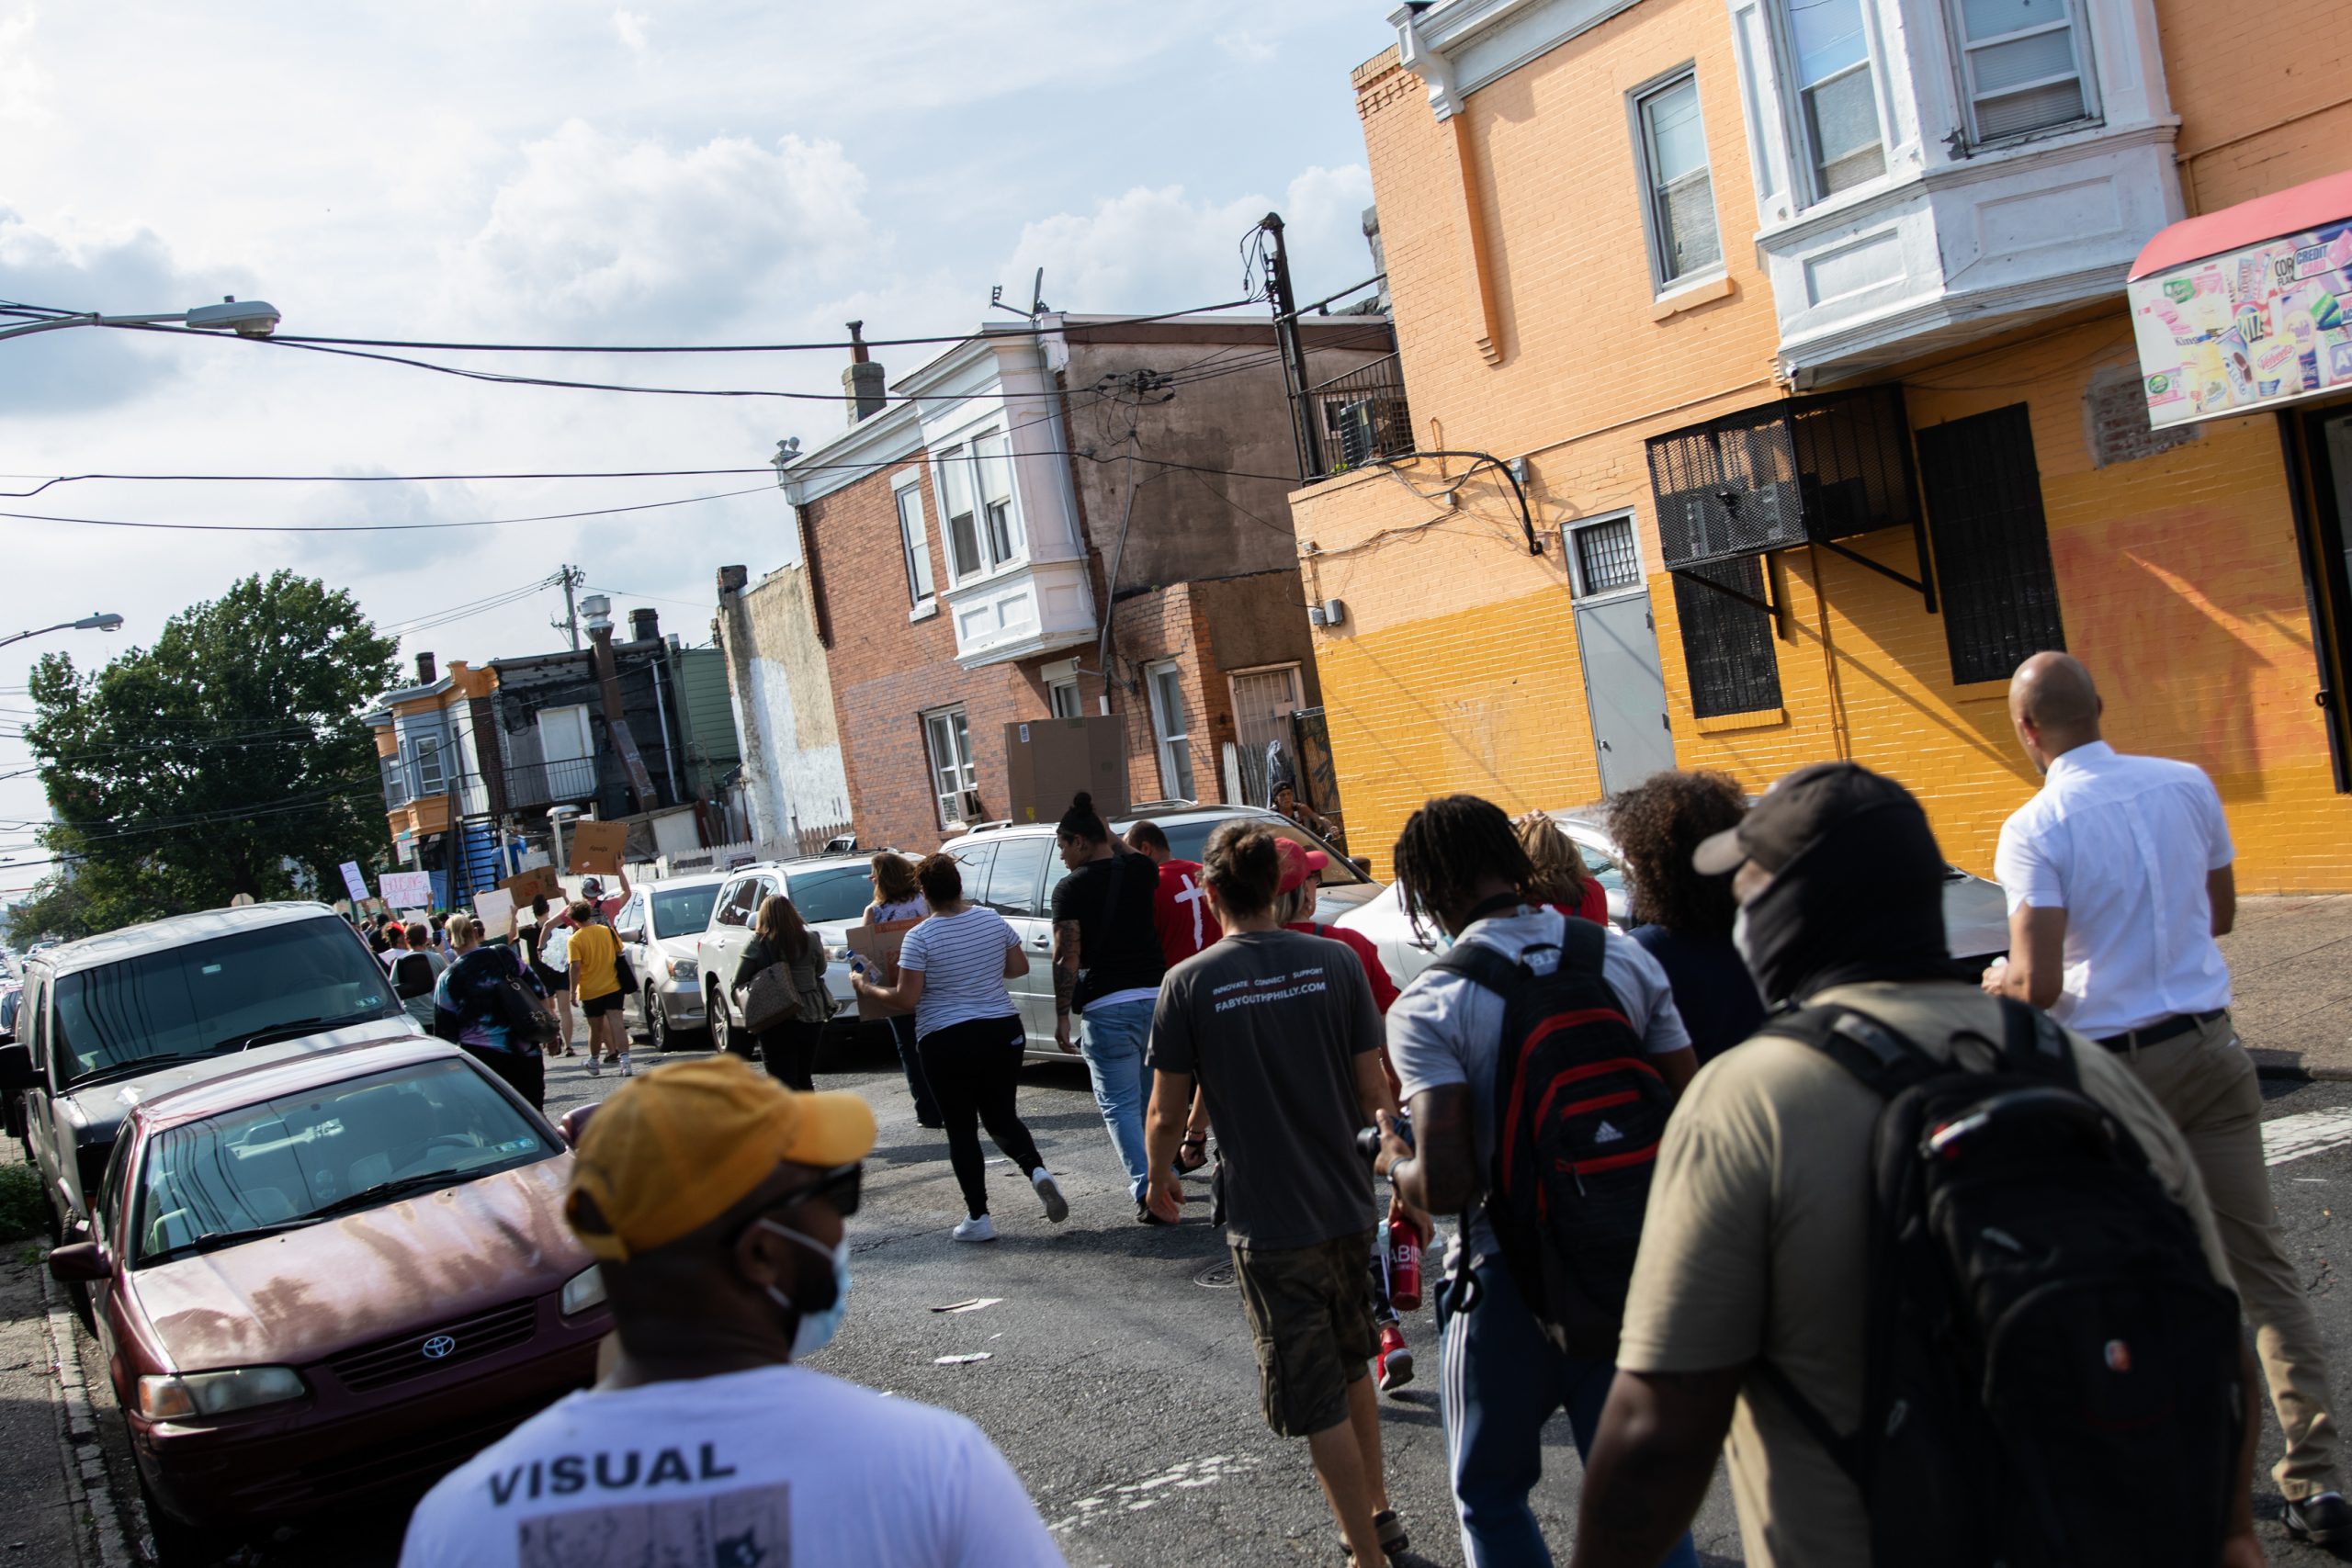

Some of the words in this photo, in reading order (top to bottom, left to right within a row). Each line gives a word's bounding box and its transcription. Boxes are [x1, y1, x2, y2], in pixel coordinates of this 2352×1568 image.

[2297, 245, 2328, 265] CREDIT
[2236, 314, 2264, 342] RITZ
[1213, 980, 1249, 995] INNOVATE
[1253, 976, 1286, 987] CONNECT
[1293, 967, 1324, 979] SUPPORT
[1215, 982, 1326, 1013] FABYOUTHPHILLY.COM
[489, 1442, 737, 1507] VISUAL
